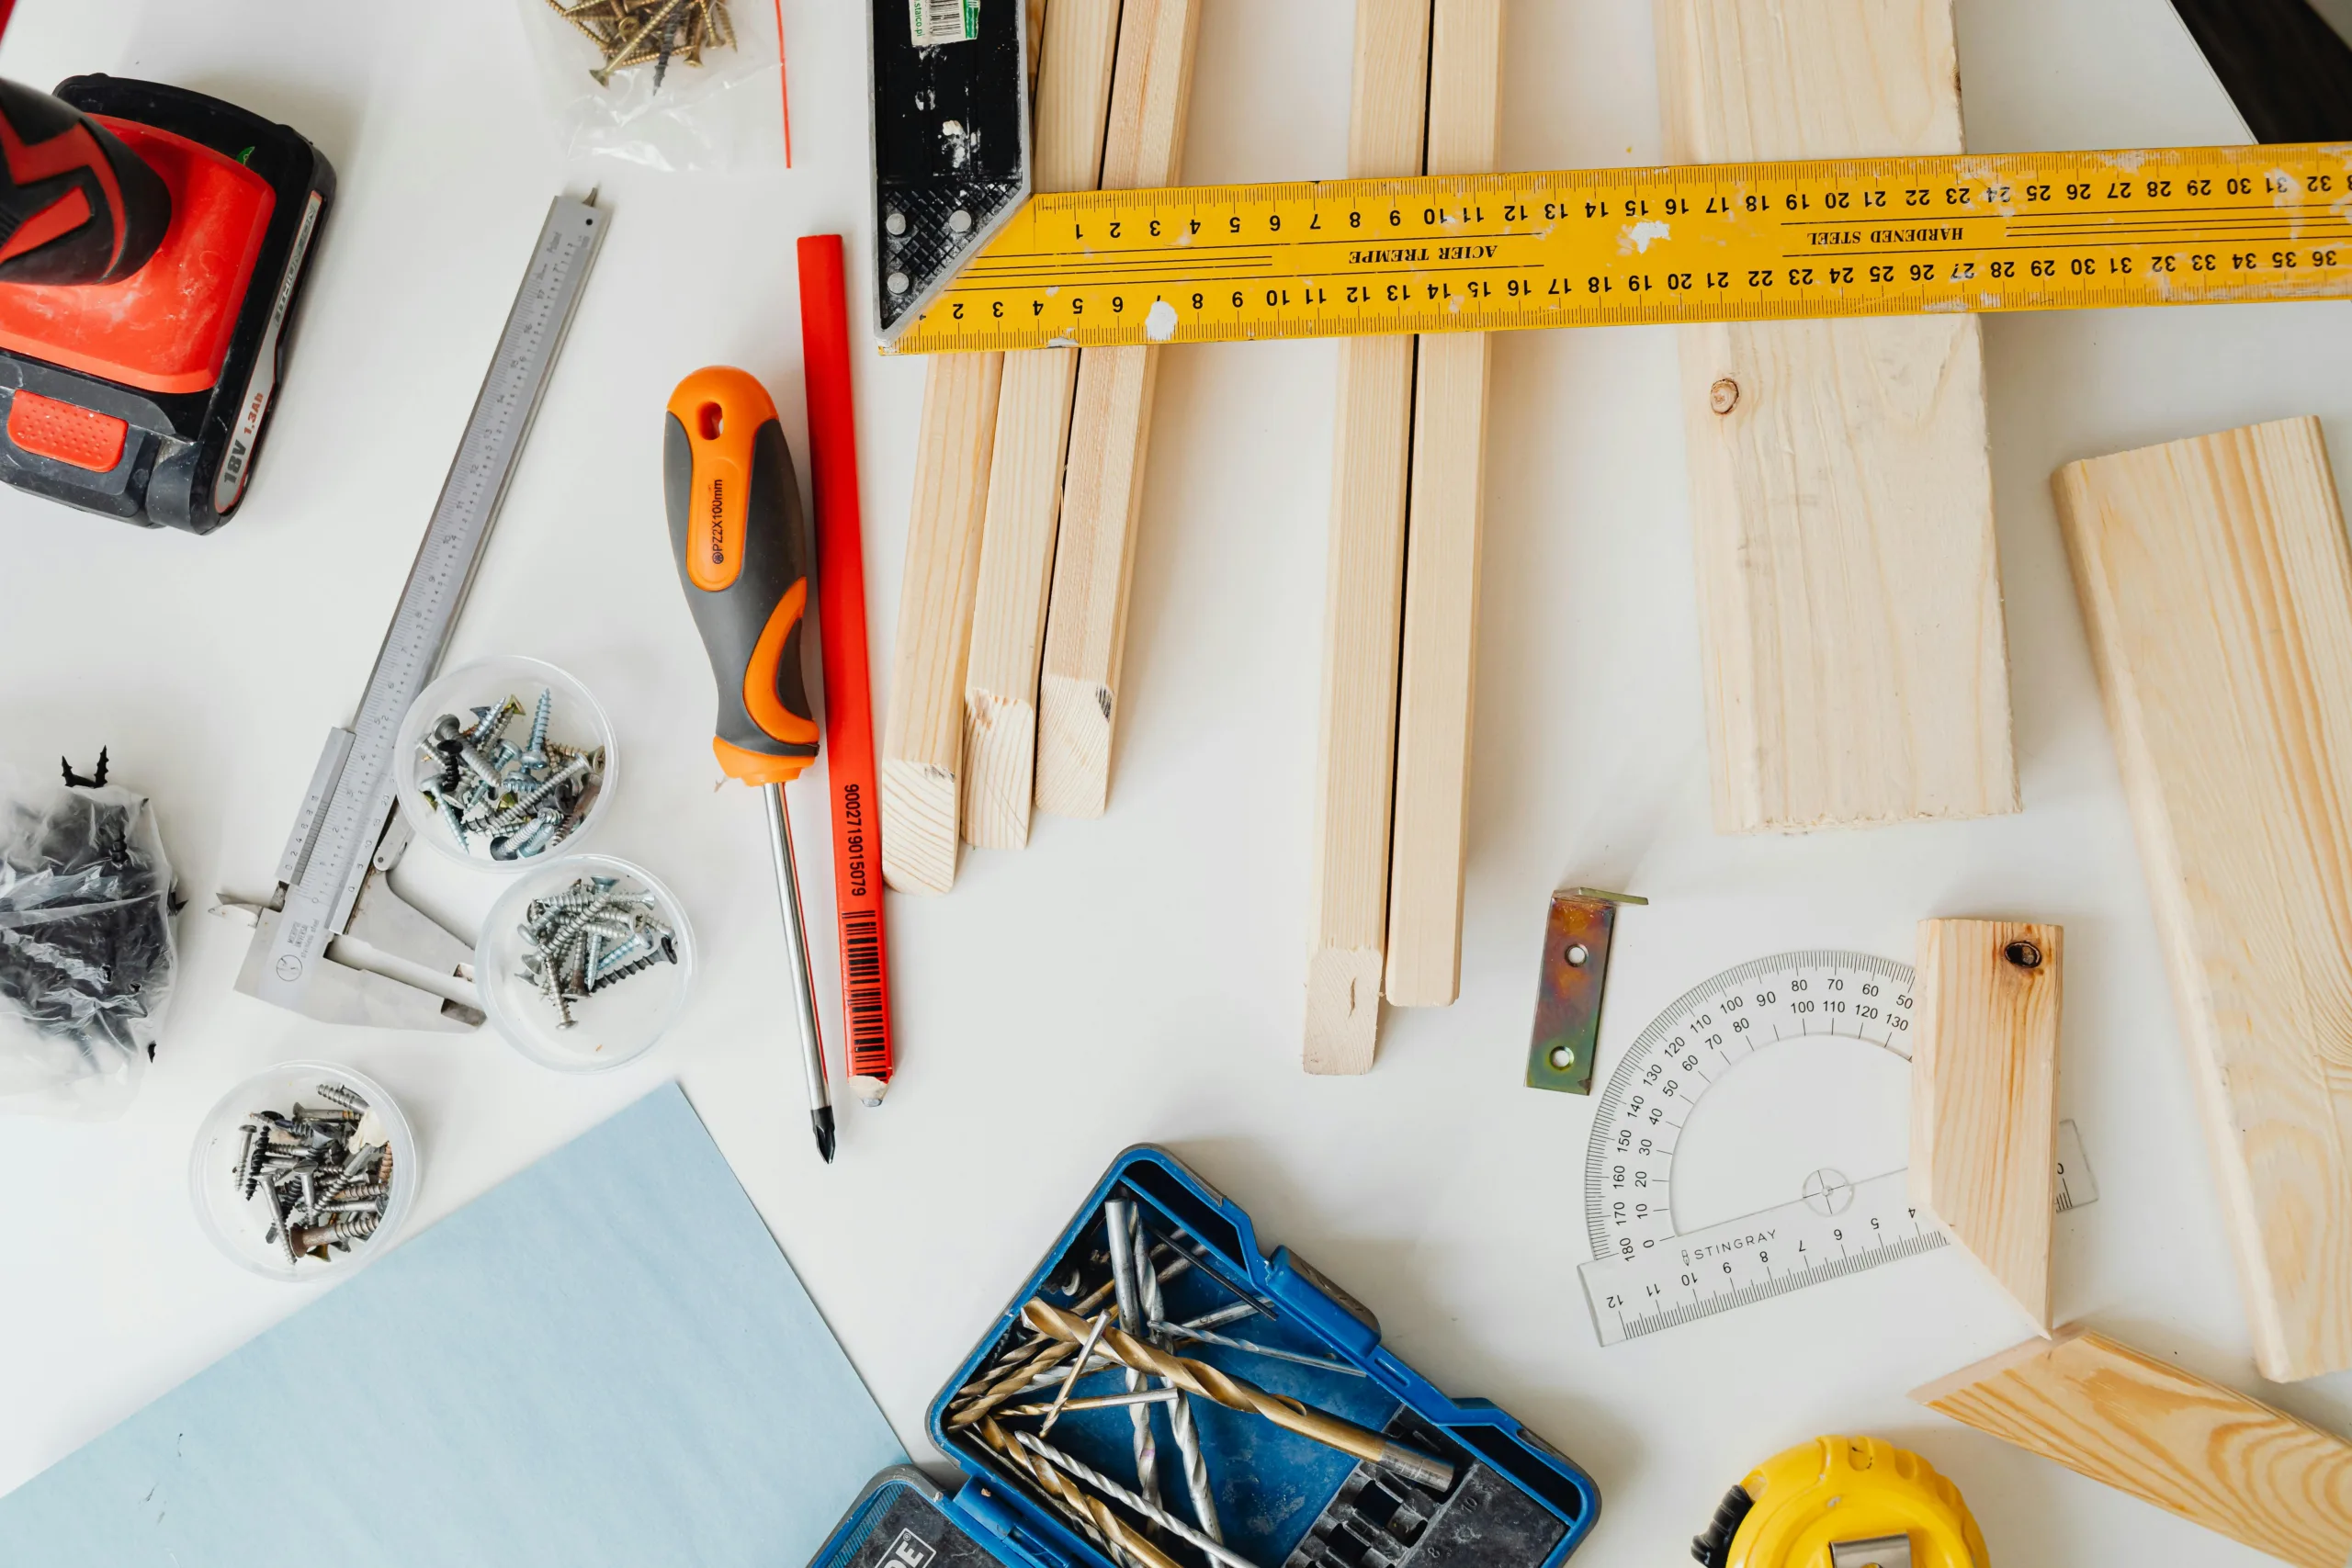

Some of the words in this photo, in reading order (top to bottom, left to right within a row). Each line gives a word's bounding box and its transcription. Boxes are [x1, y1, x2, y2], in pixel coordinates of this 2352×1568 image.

[2066, 183, 2091, 201] 26
[2107, 182, 2132, 199] 27
[2146, 180, 2171, 197] 28
[2187, 179, 2211, 197] 29
[2226, 177, 2252, 196] 30
[2265, 175, 2289, 194] 31
[2307, 175, 2332, 192] 32
[1825, 192, 1849, 209] 20
[1864, 190, 1886, 208] 21
[1905, 188, 1931, 207] 22
[1945, 187, 1971, 205] 23
[1985, 186, 2011, 204] 24
[2026, 185, 2051, 202] 25
[1584, 201, 1609, 219] 14
[1624, 199, 1649, 217] 15
[1665, 198, 1690, 216] 16
[1705, 197, 1730, 214] 17
[1745, 195, 1770, 212] 18
[1785, 194, 1810, 211] 19
[1349, 211, 1361, 229] 8
[1389, 209, 1401, 227] 9
[1423, 208, 1448, 225] 10
[1463, 207, 1485, 223] 11
[1504, 205, 1529, 222] 12
[1544, 203, 1568, 220] 13
[1149, 220, 1161, 237] 3
[1189, 219, 1202, 235] 4
[1229, 216, 1240, 233] 5
[1269, 215, 1281, 231] 6
[1309, 213, 1321, 230] 7
[1075, 223, 1084, 240] 1
[1109, 222, 1121, 239] 2
[1807, 231, 1861, 245] STEEL
[1871, 228, 1963, 243] HARDENED
[1349, 248, 1430, 264] TREMPE
[1438, 245, 1498, 260] ACIER
[2272, 251, 2297, 269] 35
[2312, 250, 2337, 267] 36
[1990, 261, 2015, 278] 28
[2030, 260, 2055, 277] 29
[2071, 258, 2096, 276] 30
[2109, 256, 2132, 274] 31
[2151, 255, 2176, 273] 32
[2192, 254, 2216, 272] 33
[2232, 253, 2256, 270] 34
[1706, 271, 1729, 288] 21
[1747, 270, 1773, 288] 22
[1788, 268, 1814, 286] 23
[1829, 266, 1854, 284] 24
[1869, 265, 1894, 283] 25
[1909, 264, 1935, 281] 26
[1951, 263, 1974, 279] 27
[1467, 281, 1491, 298] 15
[1507, 279, 1532, 297] 16
[1548, 278, 1572, 295] 17
[1588, 276, 1612, 294] 18
[1628, 275, 1653, 292] 19
[1668, 273, 1692, 290] 20
[1232, 291, 1244, 308] 9
[1266, 289, 1290, 307] 10
[1306, 288, 1327, 305] 11
[1346, 286, 1371, 303] 12
[1386, 285, 1411, 301] 13
[1427, 283, 1452, 299] 14
[992, 301, 1003, 318] 3
[1032, 300, 1044, 316] 4
[1072, 298, 1083, 315] 5
[1112, 296, 1124, 313] 6
[1192, 293, 1204, 310] 8
[953, 303, 964, 320] 2
[224, 439, 246, 484] 18V
[844, 784, 866, 897] 9002719015079
[1791, 979, 1808, 992] 80
[1827, 978, 1844, 991] 70
[1861, 983, 1879, 998] 60
[1720, 996, 1744, 1014] 100
[1756, 990, 1776, 1007] 90
[1790, 1000, 1815, 1014] 100
[1823, 1000, 1846, 1013] 110
[1895, 994, 1914, 1010] 50
[1855, 1004, 1879, 1020] 120
[1690, 1014, 1712, 1033] 110
[1732, 1017, 1749, 1033] 80
[1886, 1013, 1909, 1032] 130
[1664, 1036, 1685, 1058] 120
[1704, 1033, 1723, 1050] 70
[1681, 1055, 1699, 1072] 60
[1643, 1064, 1662, 1087] 130
[1662, 1079, 1679, 1098] 50
[1626, 1095, 1645, 1118] 140
[1648, 1108, 1663, 1125] 40
[1616, 1129, 1632, 1153] 150
[1638, 1138, 1653, 1156] 30
[1612, 1165, 1625, 1190] 160
[1634, 1171, 1647, 1189] 20
[1612, 1201, 1627, 1226] 170
[1635, 1203, 1648, 1220] 10
[1907, 1207, 1916, 1219] 4
[1870, 1217, 1880, 1230] 5
[1833, 1228, 1843, 1241] 6
[1619, 1237, 1635, 1262] 180
[1643, 1239, 1655, 1248] 0
[1694, 1229, 1776, 1260] STINGRAY
[1798, 1239, 1806, 1253] 7
[1758, 1250, 1769, 1263] 8
[1722, 1261, 1732, 1274] 9
[1680, 1272, 1698, 1287] 10
[1645, 1283, 1661, 1297] 11
[1606, 1294, 1623, 1309] 12
[1461, 1496, 1478, 1513] 10
[1427, 1546, 1441, 1559] 8
